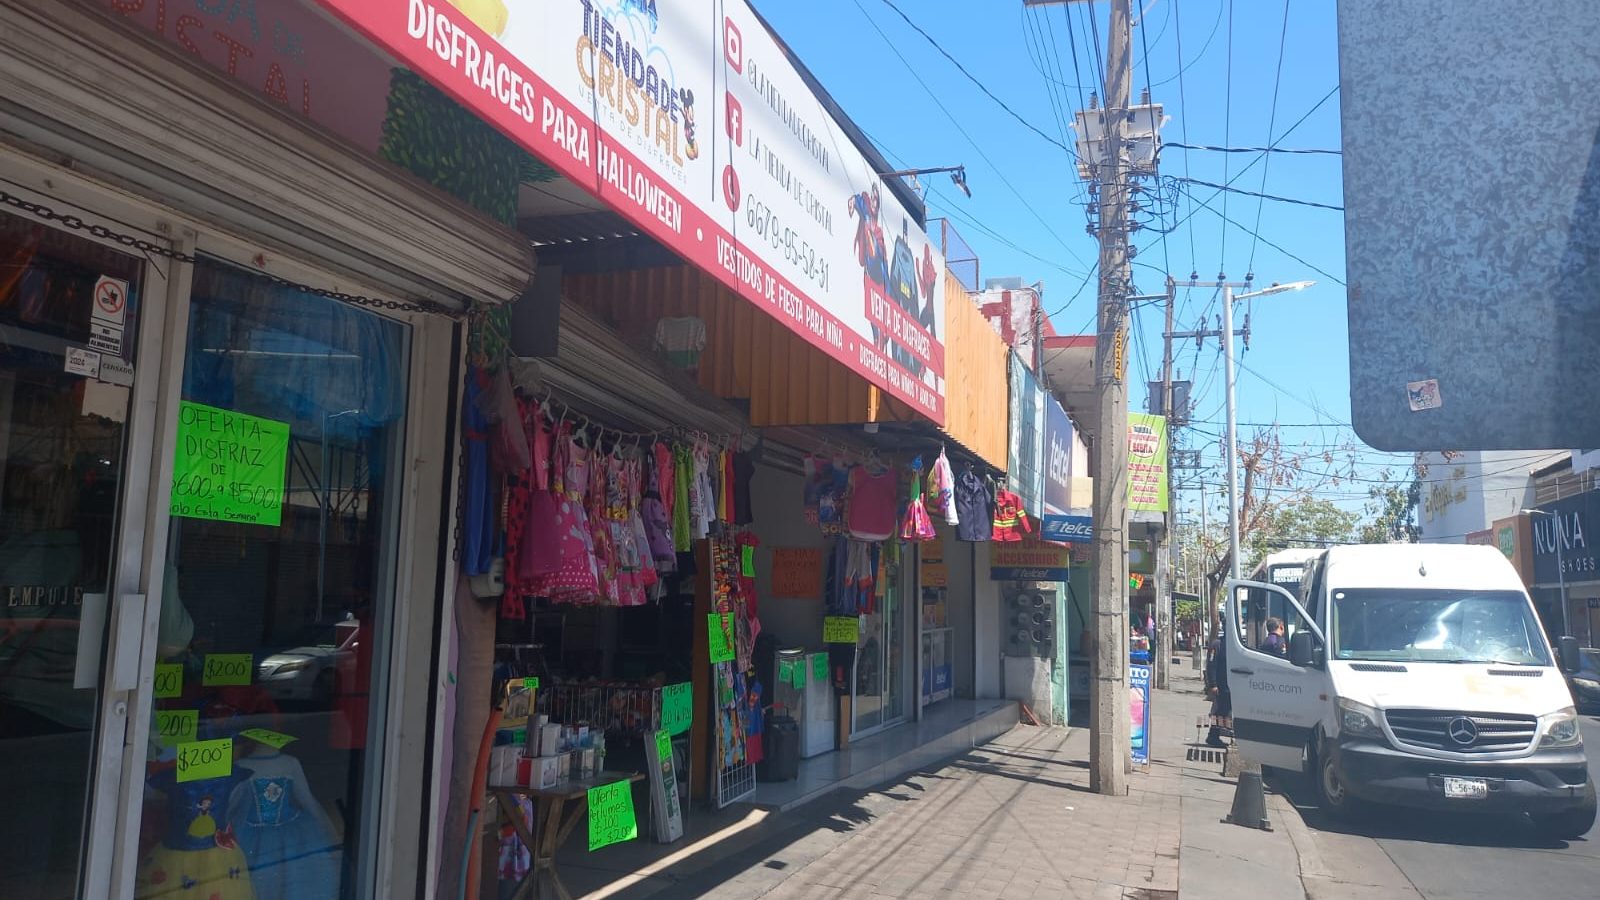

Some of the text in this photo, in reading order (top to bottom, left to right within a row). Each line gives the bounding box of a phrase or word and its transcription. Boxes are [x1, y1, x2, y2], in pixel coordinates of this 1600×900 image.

[407, 0, 682, 234] DISFRACES PARA HALLOWEEN
[576, 34, 684, 167] CRISTAL
[749, 128, 834, 237] LA TIENDA DE CRISTAL
[746, 193, 829, 293] 6679-95-58-31
[716, 235, 843, 351] VESTIDOS DE FIESTA PARA NIÑA
[871, 287, 931, 361] VENTA DE DISFRACES
[860, 342, 887, 380] DISFRACES
[888, 361, 901, 389] PARA
[186, 434, 264, 467] DISFRAZ
[211, 463, 226, 476] DE
[1050, 431, 1070, 489] telcel
[171, 504, 191, 515] olo
[1059, 521, 1093, 536] telce
[1534, 511, 1586, 556] NUNA
[1561, 558, 1595, 573] SHOES
[8, 585, 84, 607] EMPUJE
